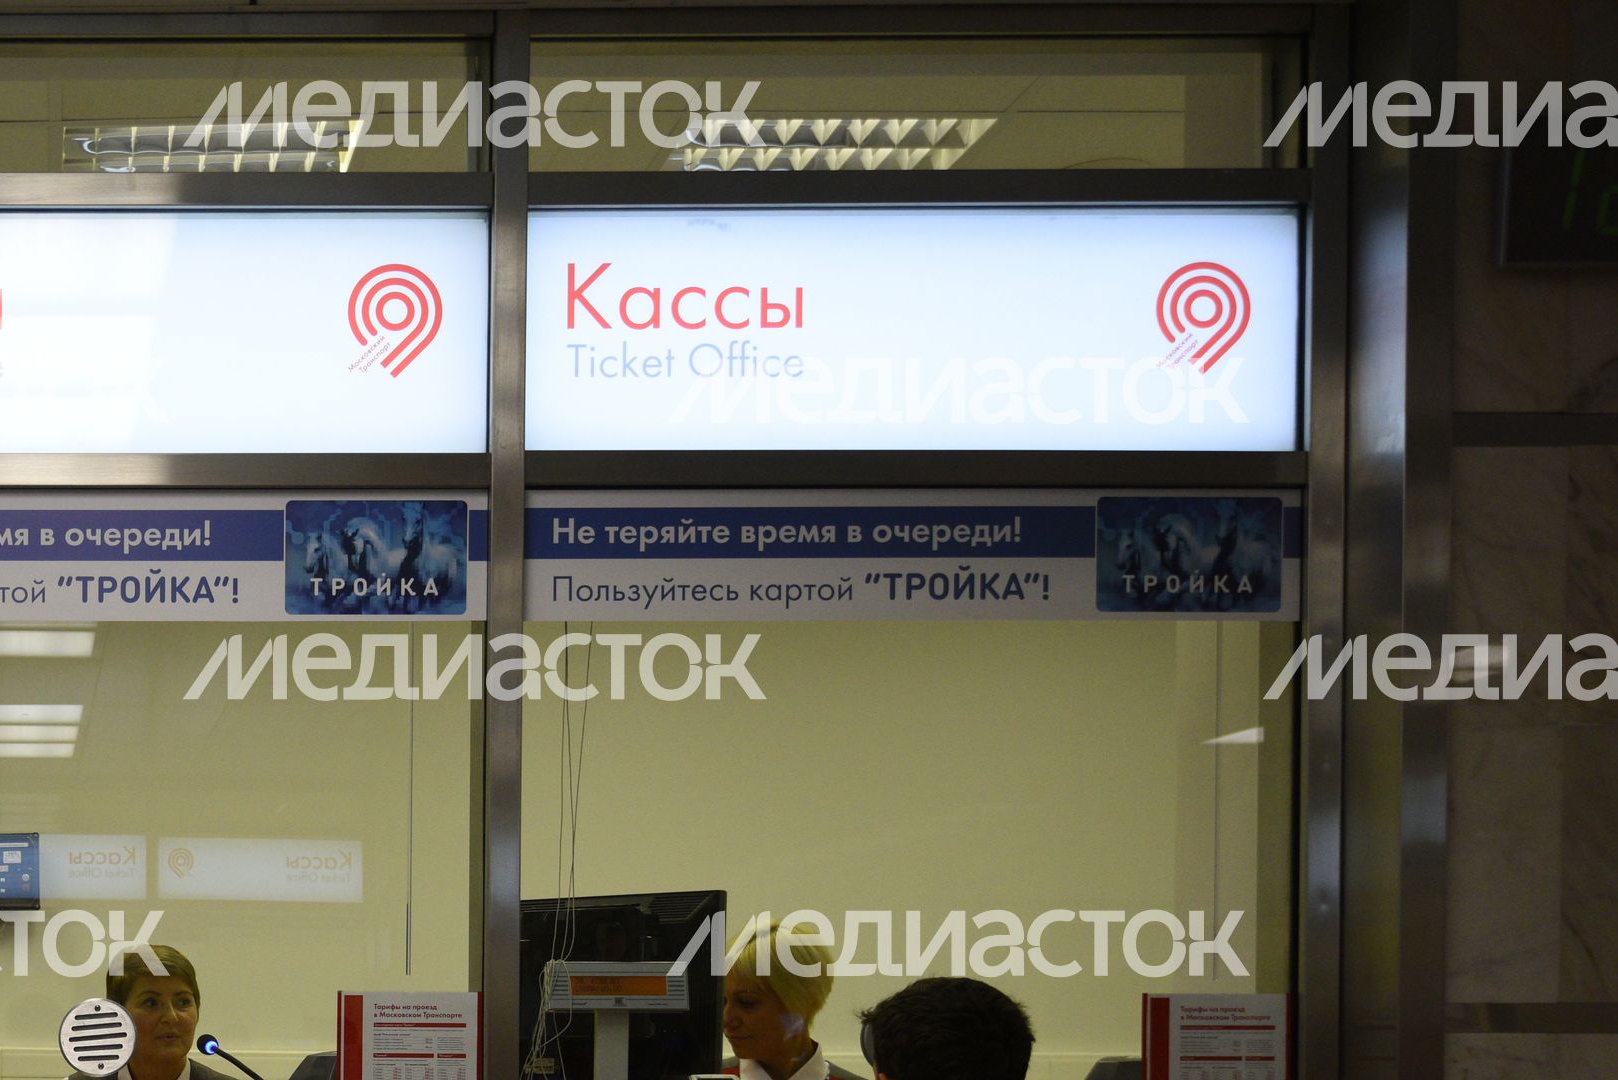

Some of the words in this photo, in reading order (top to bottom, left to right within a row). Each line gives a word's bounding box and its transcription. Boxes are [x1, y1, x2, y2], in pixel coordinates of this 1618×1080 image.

[567, 263, 802, 329] Кассы
[568, 341, 675, 379] Ticket
[689, 341, 804, 379] Office
[41, 529, 54, 545] в
[65, 520, 210, 554] очереди!
[553, 518, 595, 544] Не
[605, 519, 729, 552] теряйте
[742, 526, 835, 551] время
[848, 526, 862, 542] в
[873, 517, 1020, 550] очереди!
[311, 572, 439, 596] ТРОЙКА
[554, 576, 738, 609] Пользуйтесь
[751, 577, 852, 609] картой
[1123, 573, 1252, 595] ТРОЙКА
